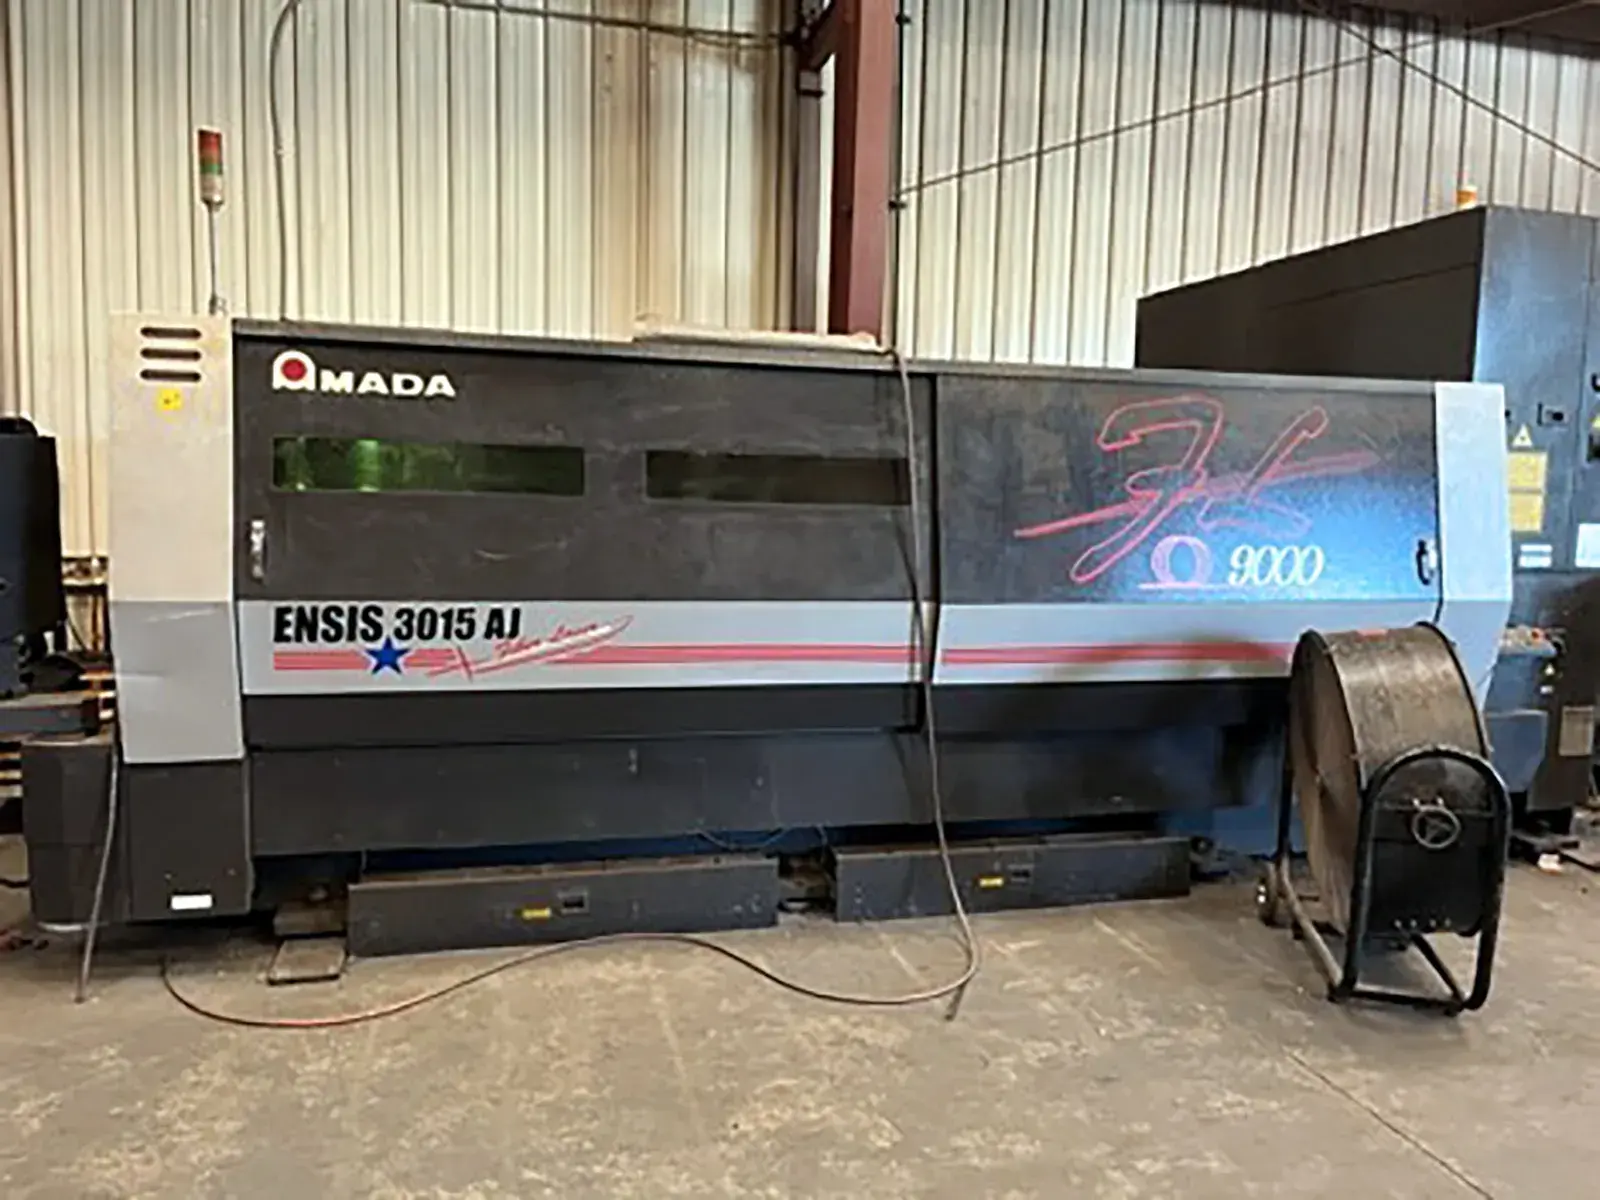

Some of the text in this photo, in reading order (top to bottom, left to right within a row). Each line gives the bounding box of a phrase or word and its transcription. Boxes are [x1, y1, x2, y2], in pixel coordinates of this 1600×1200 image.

[272, 350, 456, 397] AMADA
[1228, 544, 1325, 586] 9000
[273, 605, 521, 643] ENSIS 3015 AJ
